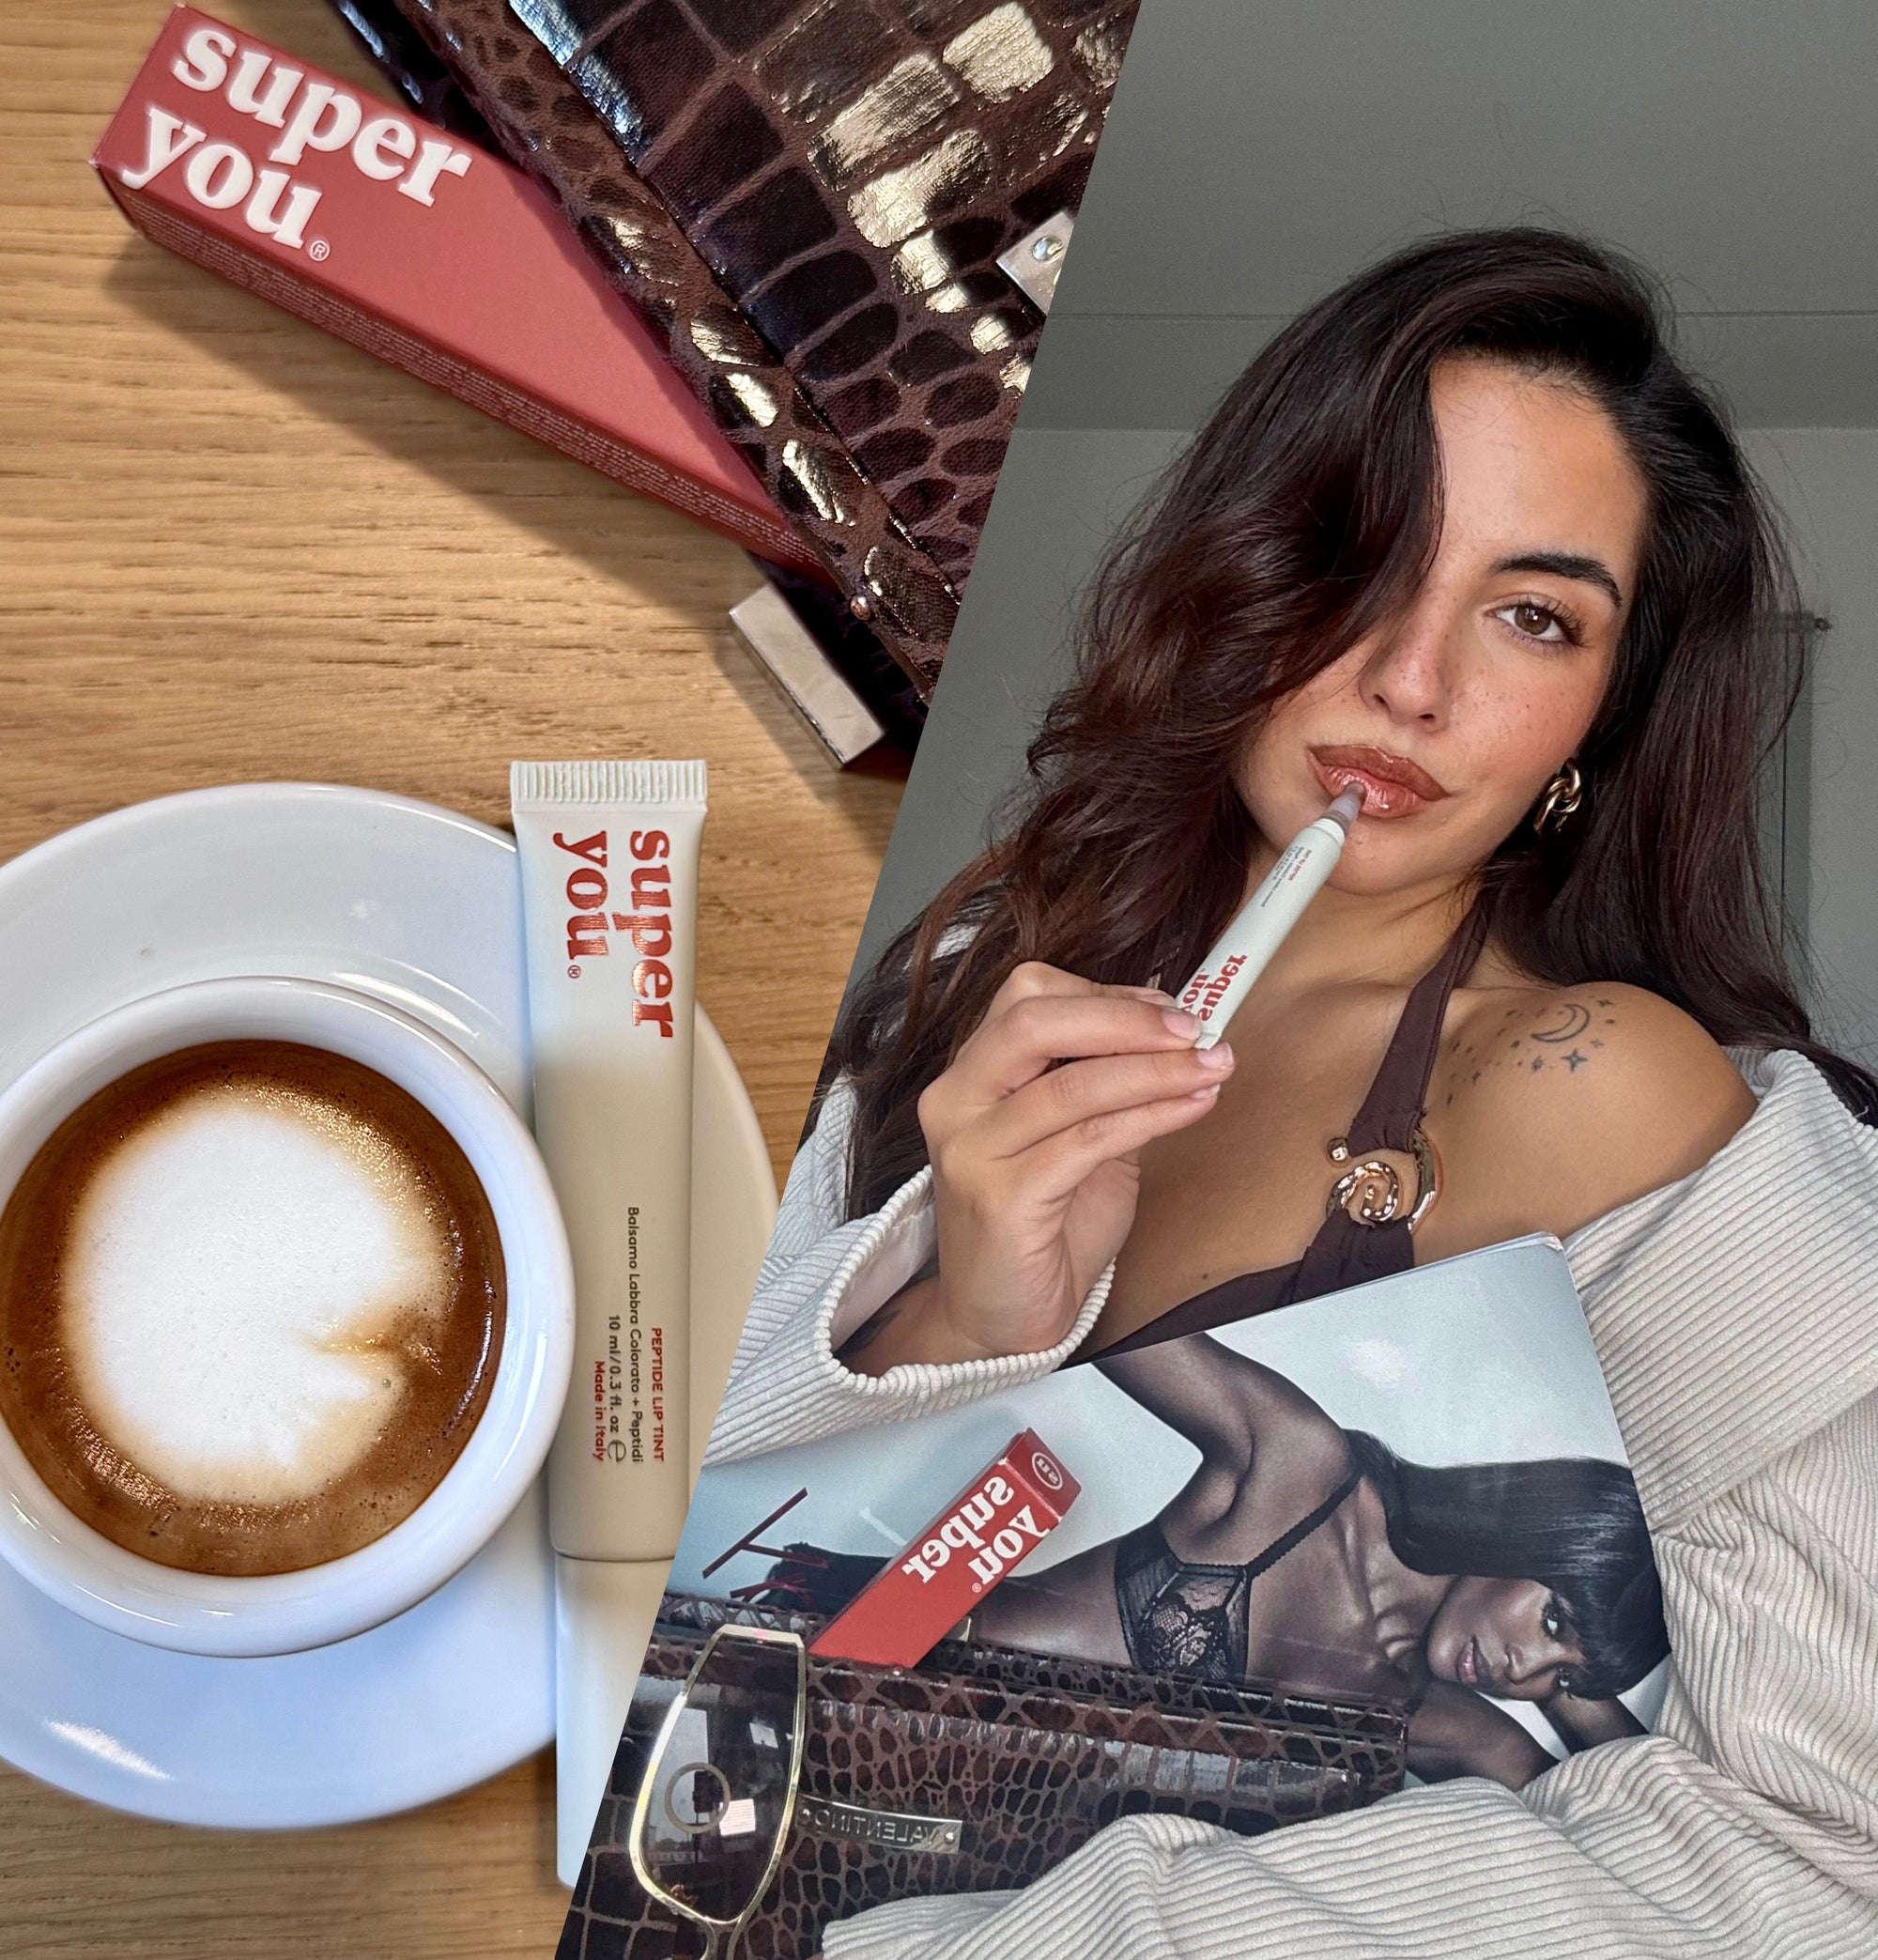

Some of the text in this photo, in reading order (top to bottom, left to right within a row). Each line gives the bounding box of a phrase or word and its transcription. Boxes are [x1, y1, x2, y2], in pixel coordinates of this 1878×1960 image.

[171, 26, 472, 208] super
[612, 829, 673, 1038] super
[627, 1206, 639, 1270] Balsamo
[608, 1315, 622, 1331] 10
[628, 1273, 641, 1324] Labbra
[629, 1328, 642, 1394] Colorato
[593, 1360, 608, 1462] Made in Italy
[609, 1396, 622, 1411] fl.
[609, 1414, 620, 1433] oz
[651, 1327, 665, 1462] PEPTIDE LIP TINT
[628, 1411, 644, 1462] Peptidi
